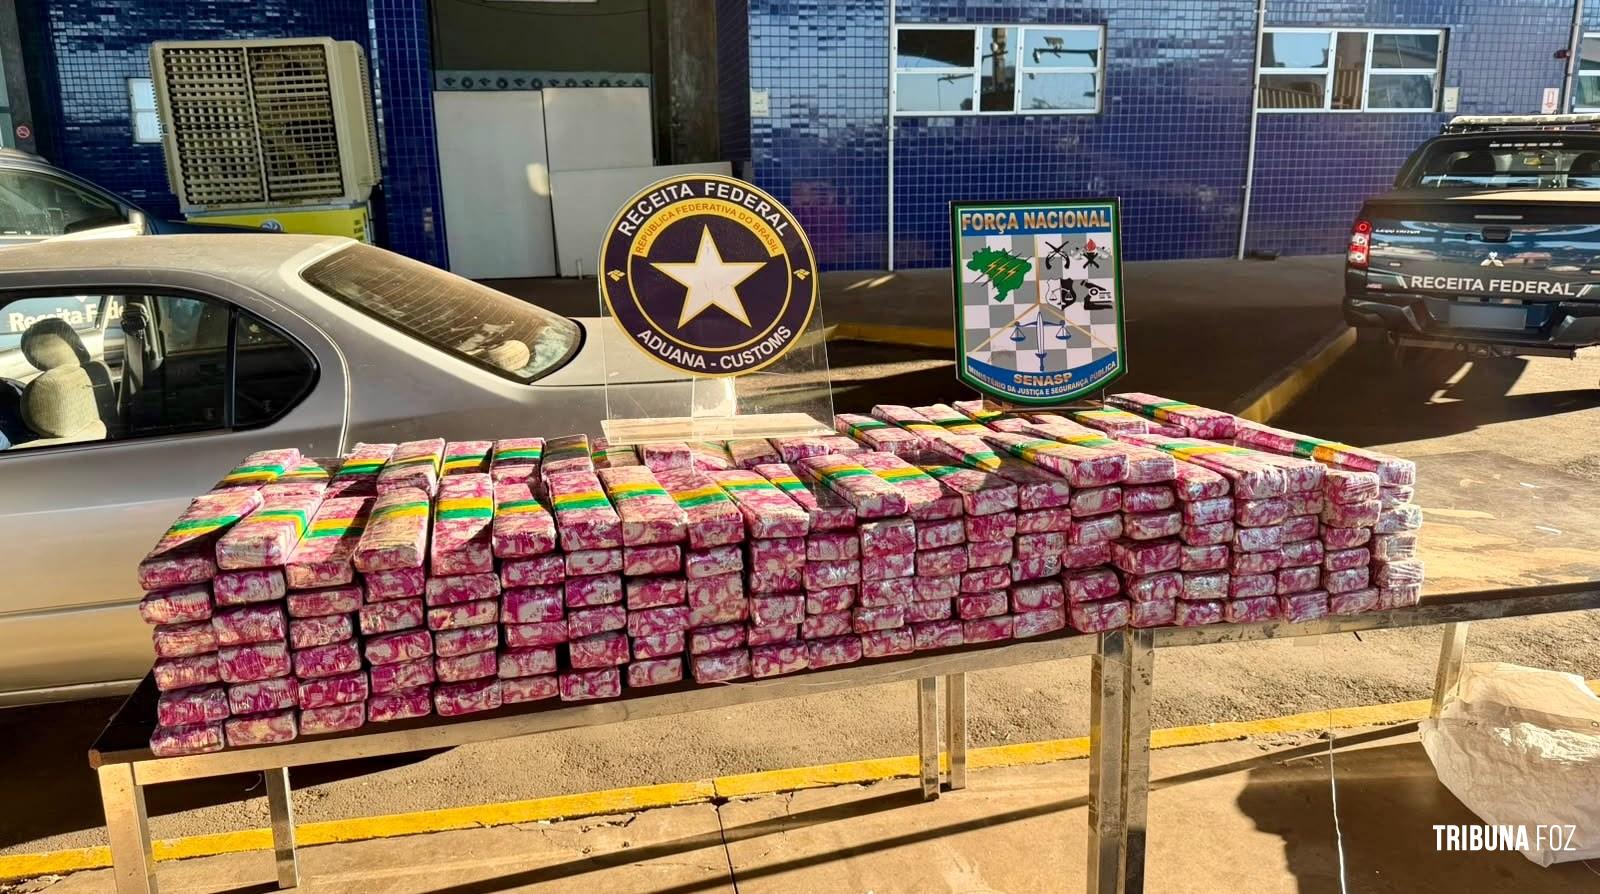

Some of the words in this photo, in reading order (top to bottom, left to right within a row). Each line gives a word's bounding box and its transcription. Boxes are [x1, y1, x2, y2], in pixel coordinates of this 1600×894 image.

[617, 183, 695, 237] RECEITA
[704, 182, 789, 237] FEDERAL
[675, 203, 737, 217] FEDERATIVA
[738, 212, 753, 224] DO
[752, 222, 779, 254] BRASIL
[962, 212, 1019, 234] FORÇA
[1023, 210, 1111, 230] NACIONAL
[1411, 276, 1485, 292] RECEITA
[1489, 279, 1575, 296] FEDERAL
[637, 329, 706, 369] ADUANA
[720, 325, 792, 369] CUSTOMS
[1013, 372, 1073, 387] SENASP
[1017, 387, 1044, 397] JUSTIÇA
